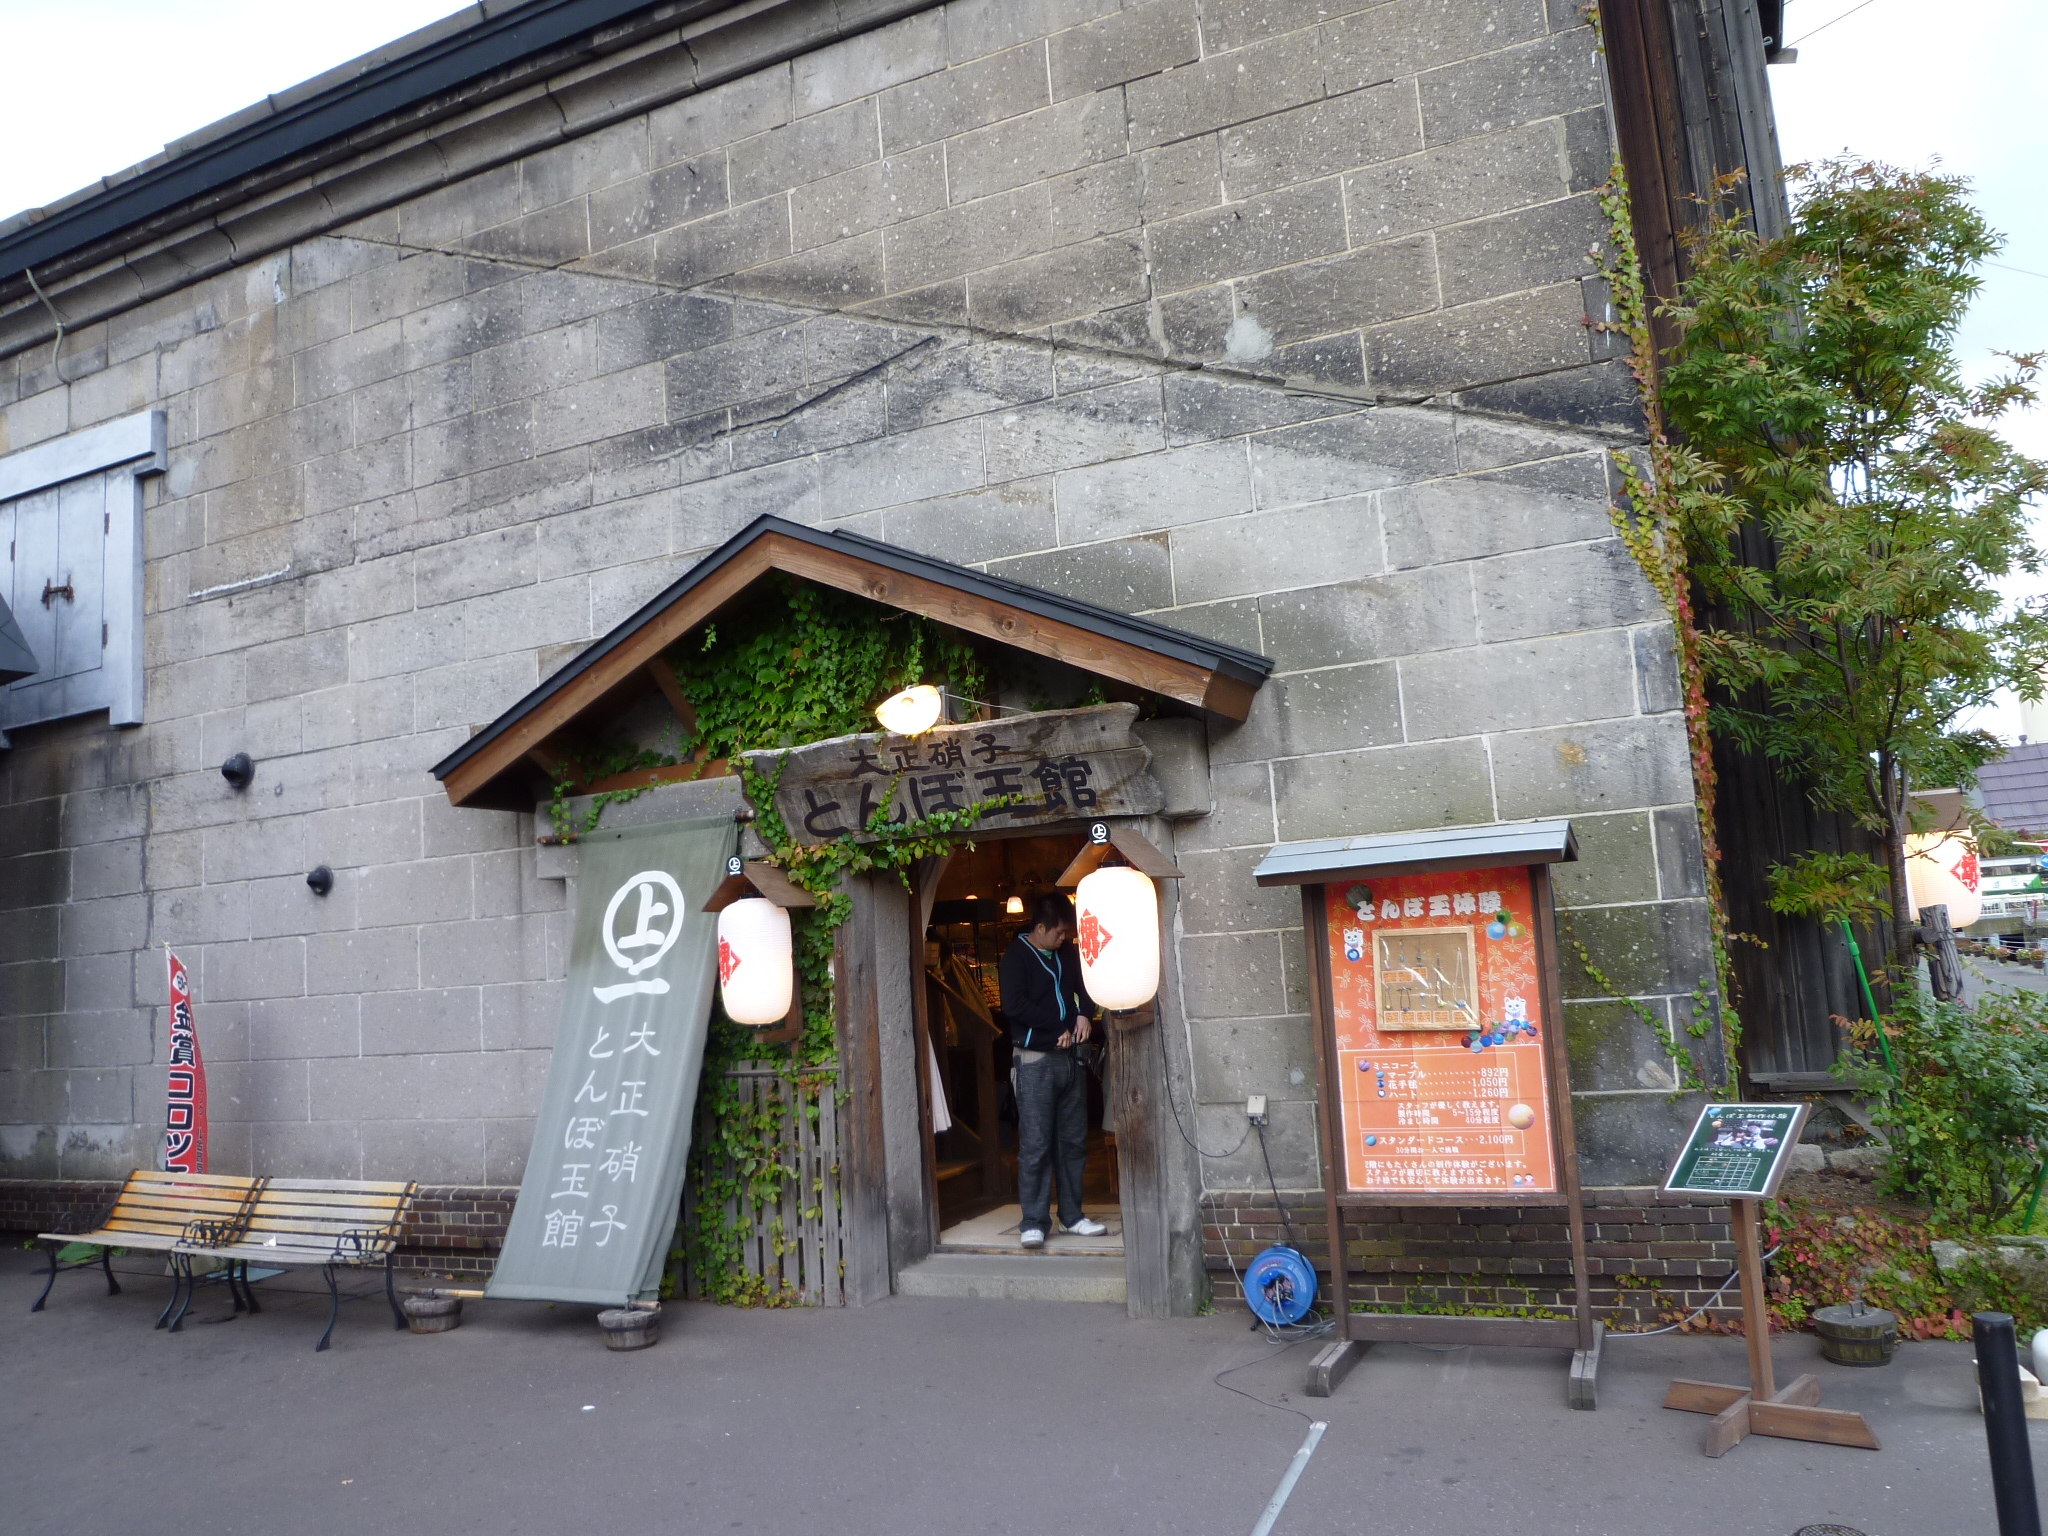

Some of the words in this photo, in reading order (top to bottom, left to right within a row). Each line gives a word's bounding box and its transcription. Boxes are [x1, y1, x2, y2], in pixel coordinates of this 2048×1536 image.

[849, 734, 1011, 777] 大正硝子
[1356, 891, 1502, 921] とんぼ玉体験
[1373, 1062, 1418, 1070] ミニコース
[1388, 1071, 1426, 1079] マーブル
[1389, 1090, 1417, 1099] ハート
[542, 1027, 613, 1249] とんぼ玉館
[589, 1022, 661, 1247] 大正硝子
[1379, 1136, 1464, 1144] スタンダードコース
